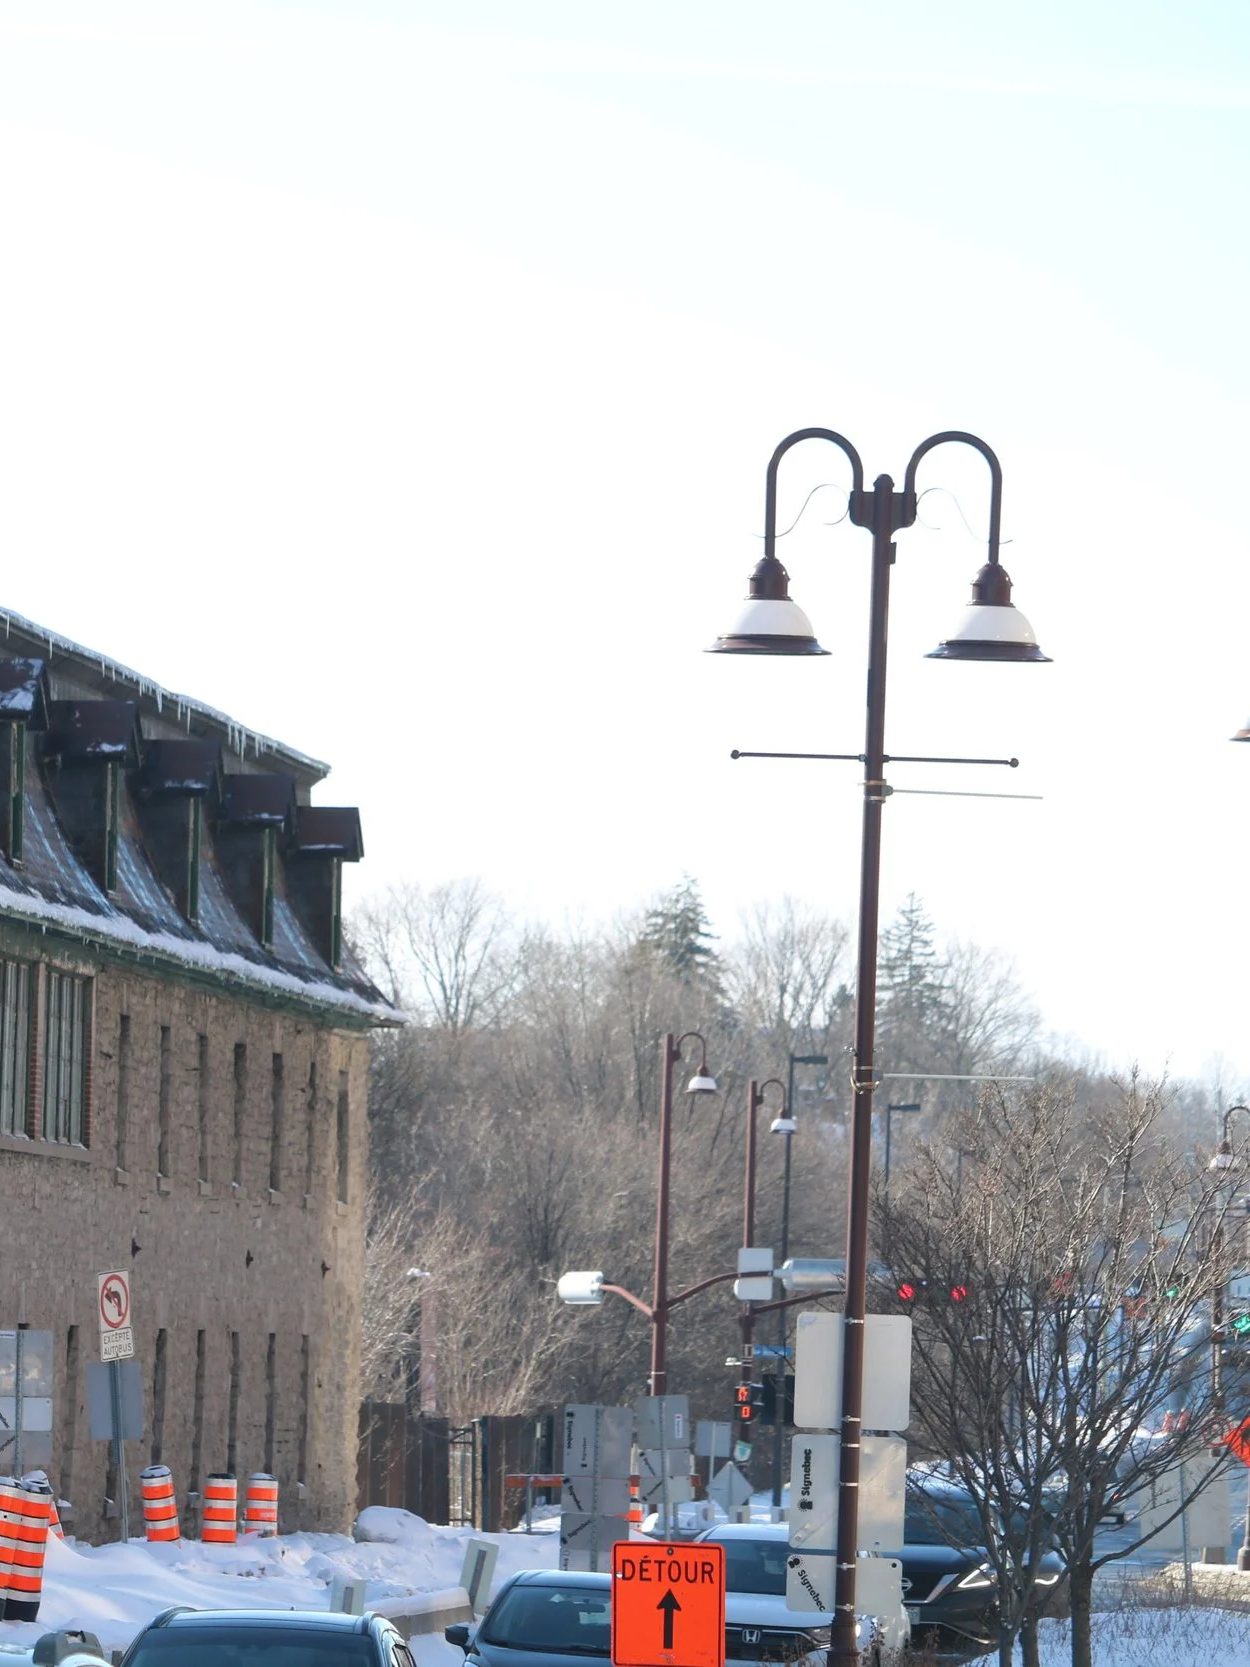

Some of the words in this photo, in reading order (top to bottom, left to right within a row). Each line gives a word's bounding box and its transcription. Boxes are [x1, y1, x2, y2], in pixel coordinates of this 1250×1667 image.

[103, 1343, 133, 1356] AUTOBUS
[801, 1448, 812, 1496] Signebec
[621, 1555, 715, 1585] DÉTOUR
[797, 1569, 827, 1613] Signebec
